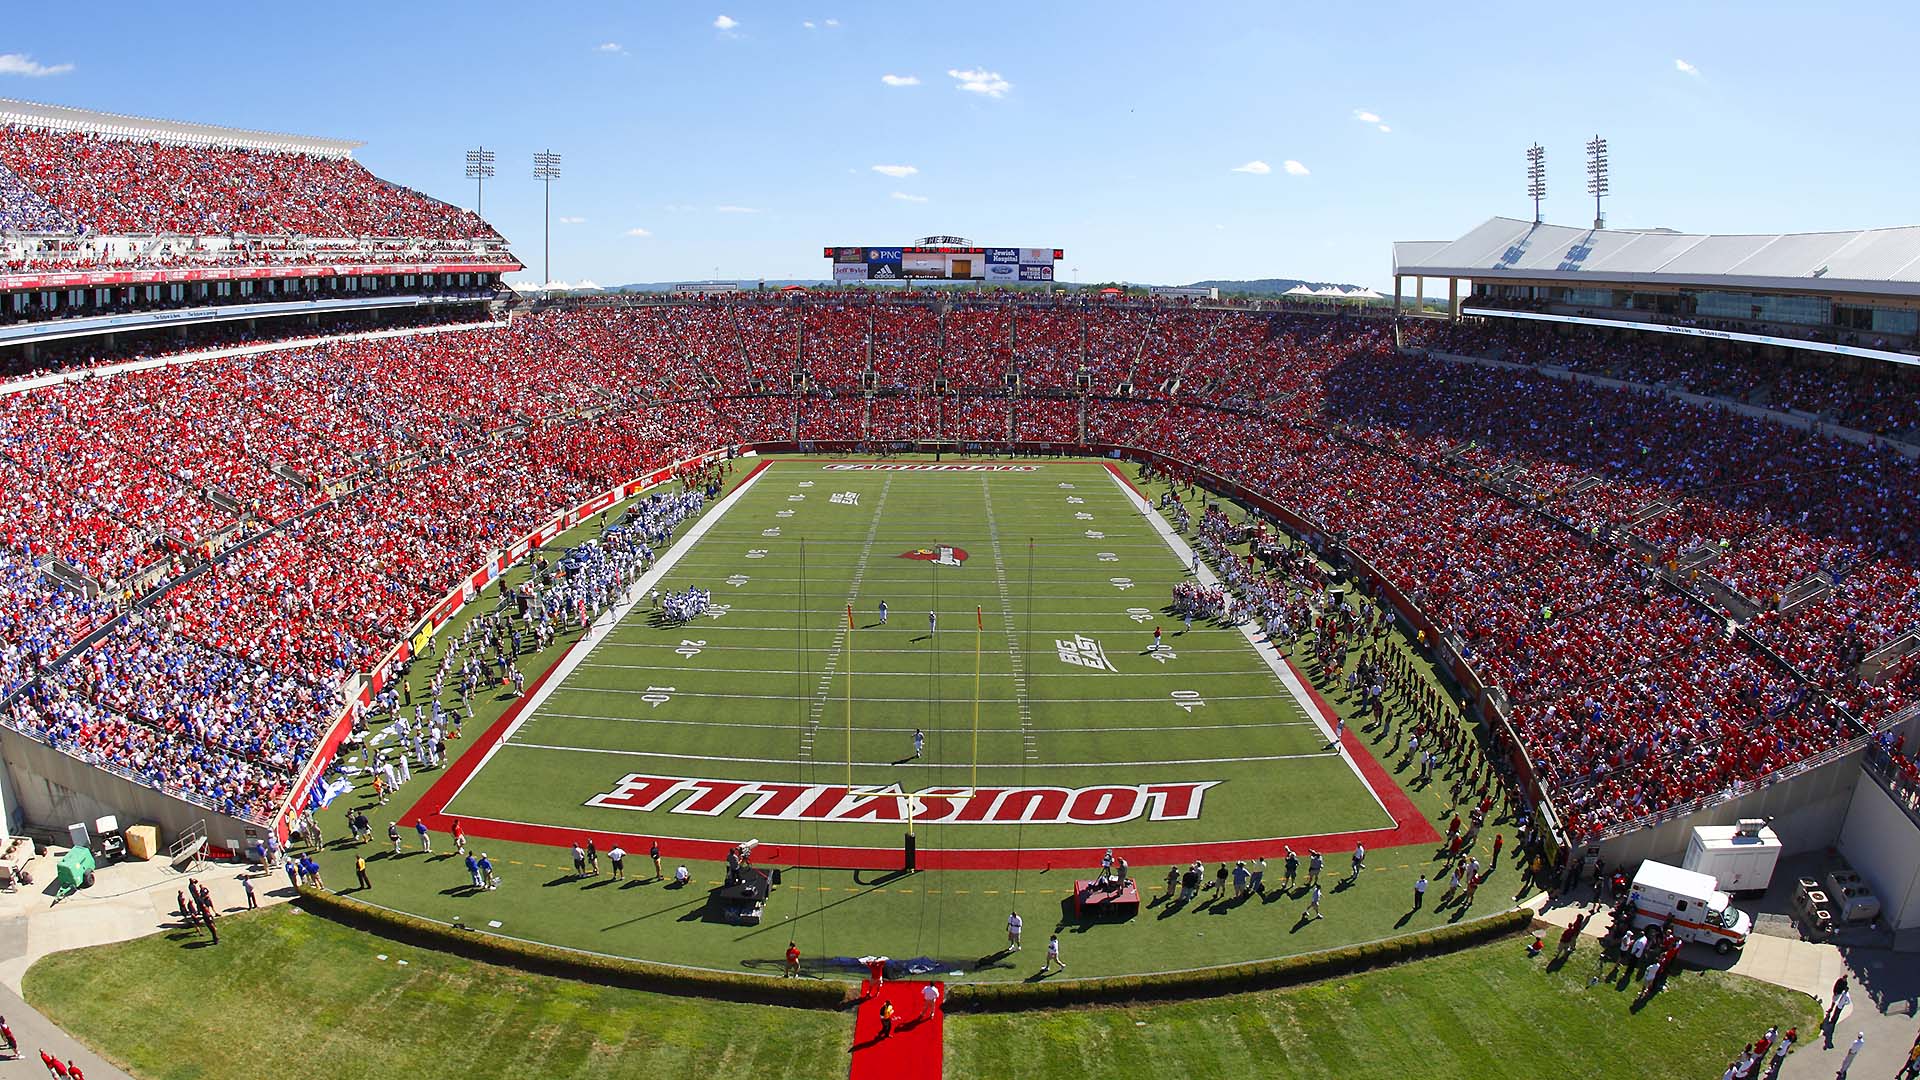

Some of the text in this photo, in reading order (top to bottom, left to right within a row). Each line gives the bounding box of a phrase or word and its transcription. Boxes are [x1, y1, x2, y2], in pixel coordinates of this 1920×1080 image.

[880, 250, 901, 259] PNC
[675, 640, 707, 654] 20
[1055, 639, 1083, 666] BIG
[1074, 633, 1106, 670] EAST
[641, 686, 676, 702] 10
[1171, 690, 1206, 707] 10
[580, 772, 1225, 825] LOUISVILLE
